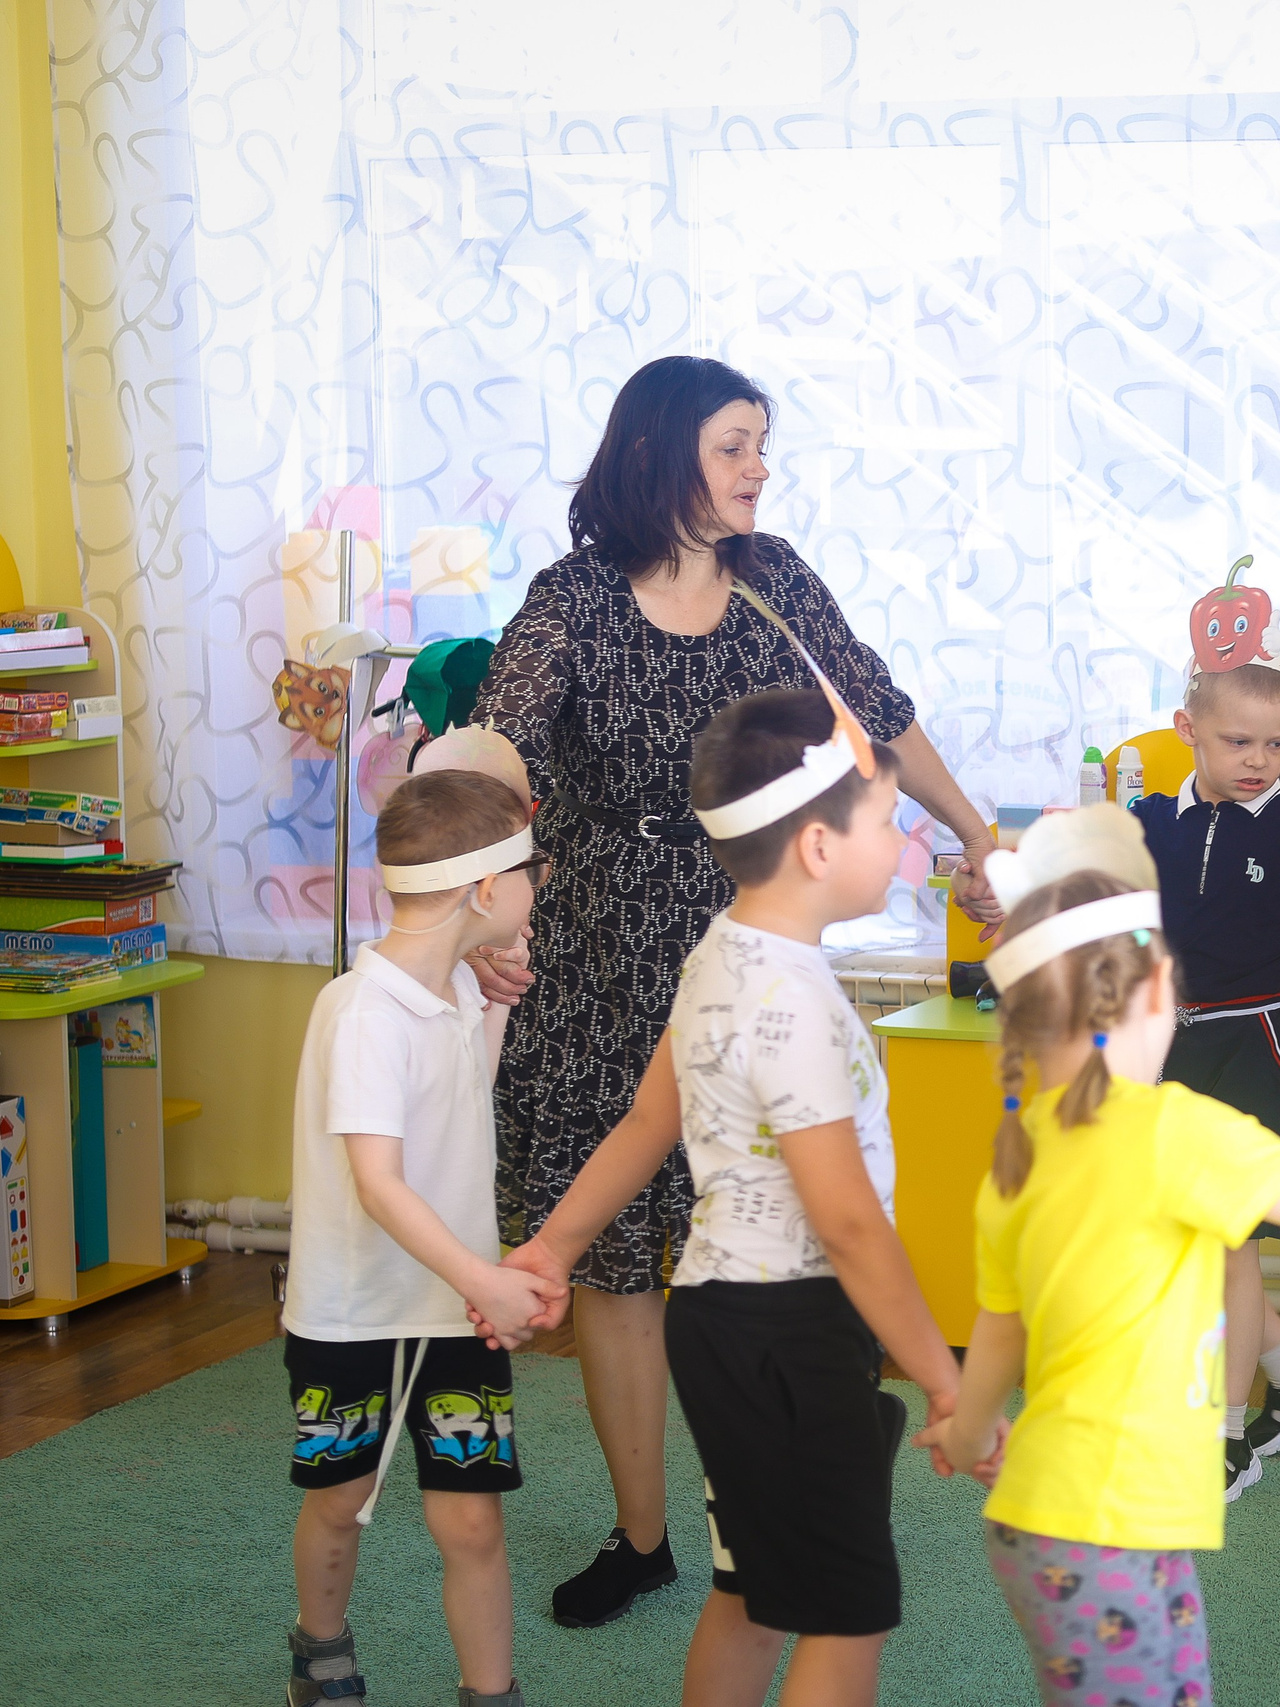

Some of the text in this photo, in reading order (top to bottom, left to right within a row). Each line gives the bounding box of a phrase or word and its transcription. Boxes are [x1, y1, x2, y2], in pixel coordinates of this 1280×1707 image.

[5, 934, 54, 951] MEMO
[121, 929, 152, 950] MEMO
[756, 1009, 796, 1025] JUST
[755, 1026, 792, 1044] PLAY
